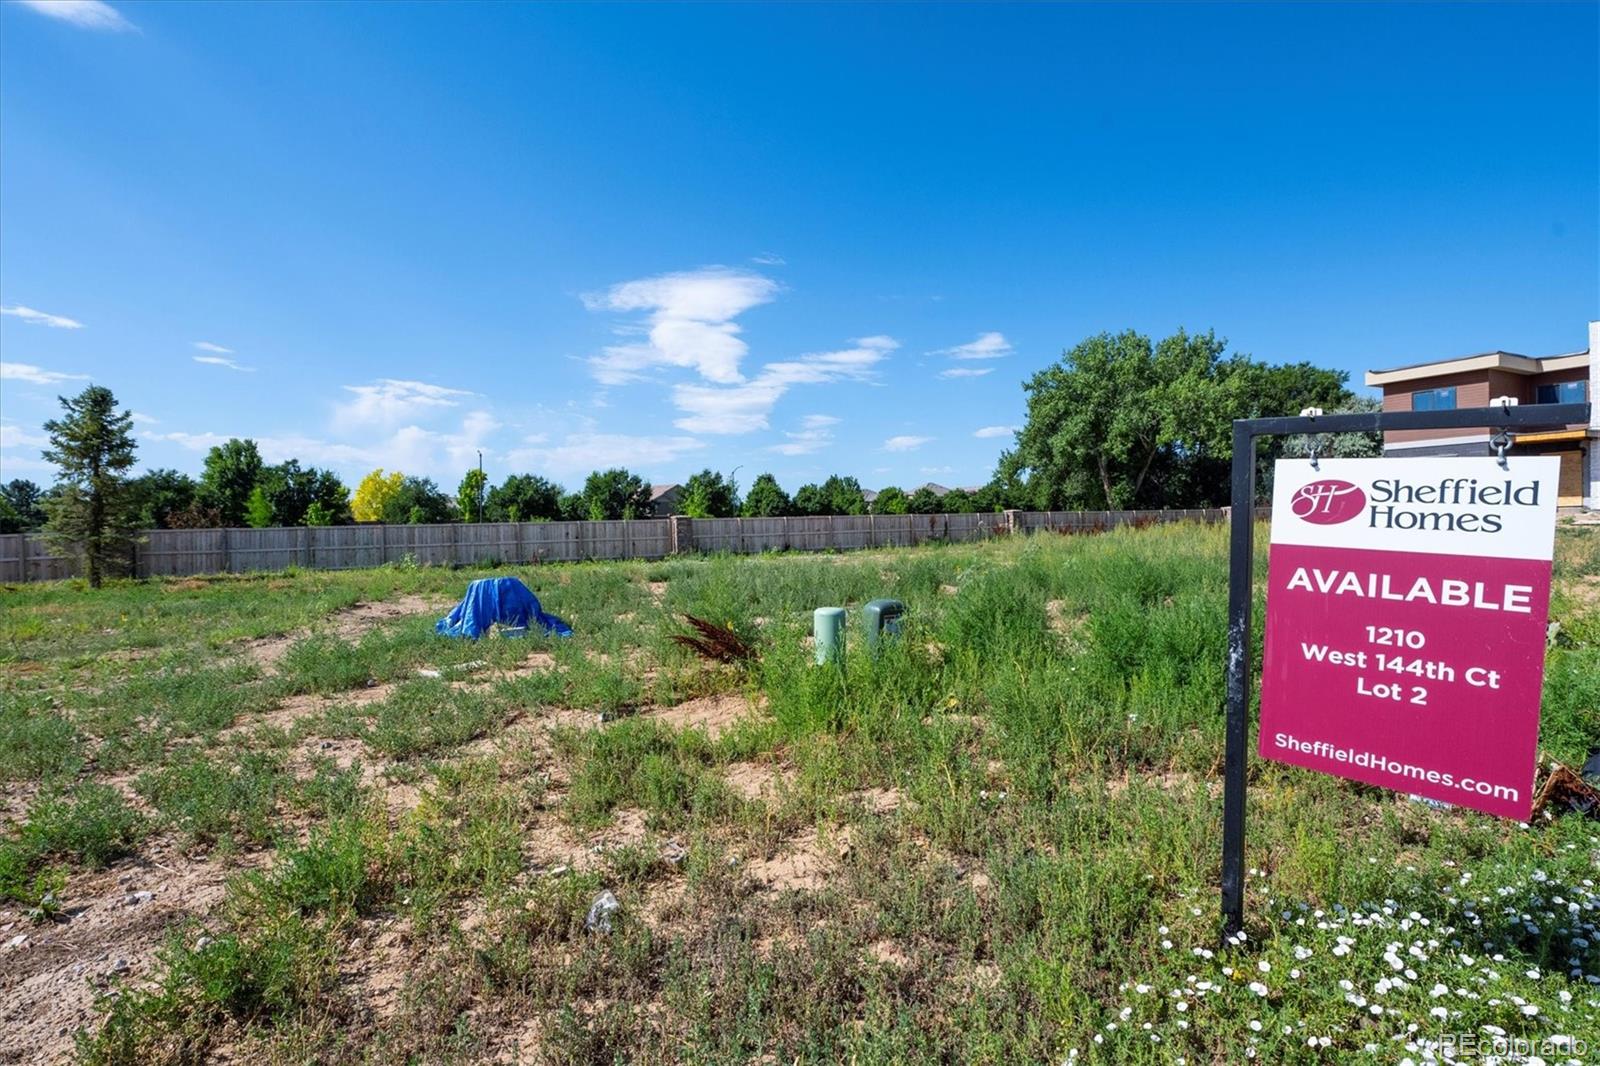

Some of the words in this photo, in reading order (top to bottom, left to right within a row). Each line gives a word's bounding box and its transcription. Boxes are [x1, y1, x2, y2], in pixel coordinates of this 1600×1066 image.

[1371, 479, 1540, 506] Sheffield
[1369, 506, 1502, 533] Homes
[1286, 567, 1533, 614] AVAILABLE
[1365, 625, 1426, 650] 1210
[1301, 642, 1368, 669] West
[1375, 653, 1455, 683] 144th
[1465, 666, 1501, 690] Ct
[1356, 677, 1402, 701] Lot
[1410, 686, 1428, 706] 2
[1275, 732, 1519, 802] SheffieldHomes.com
